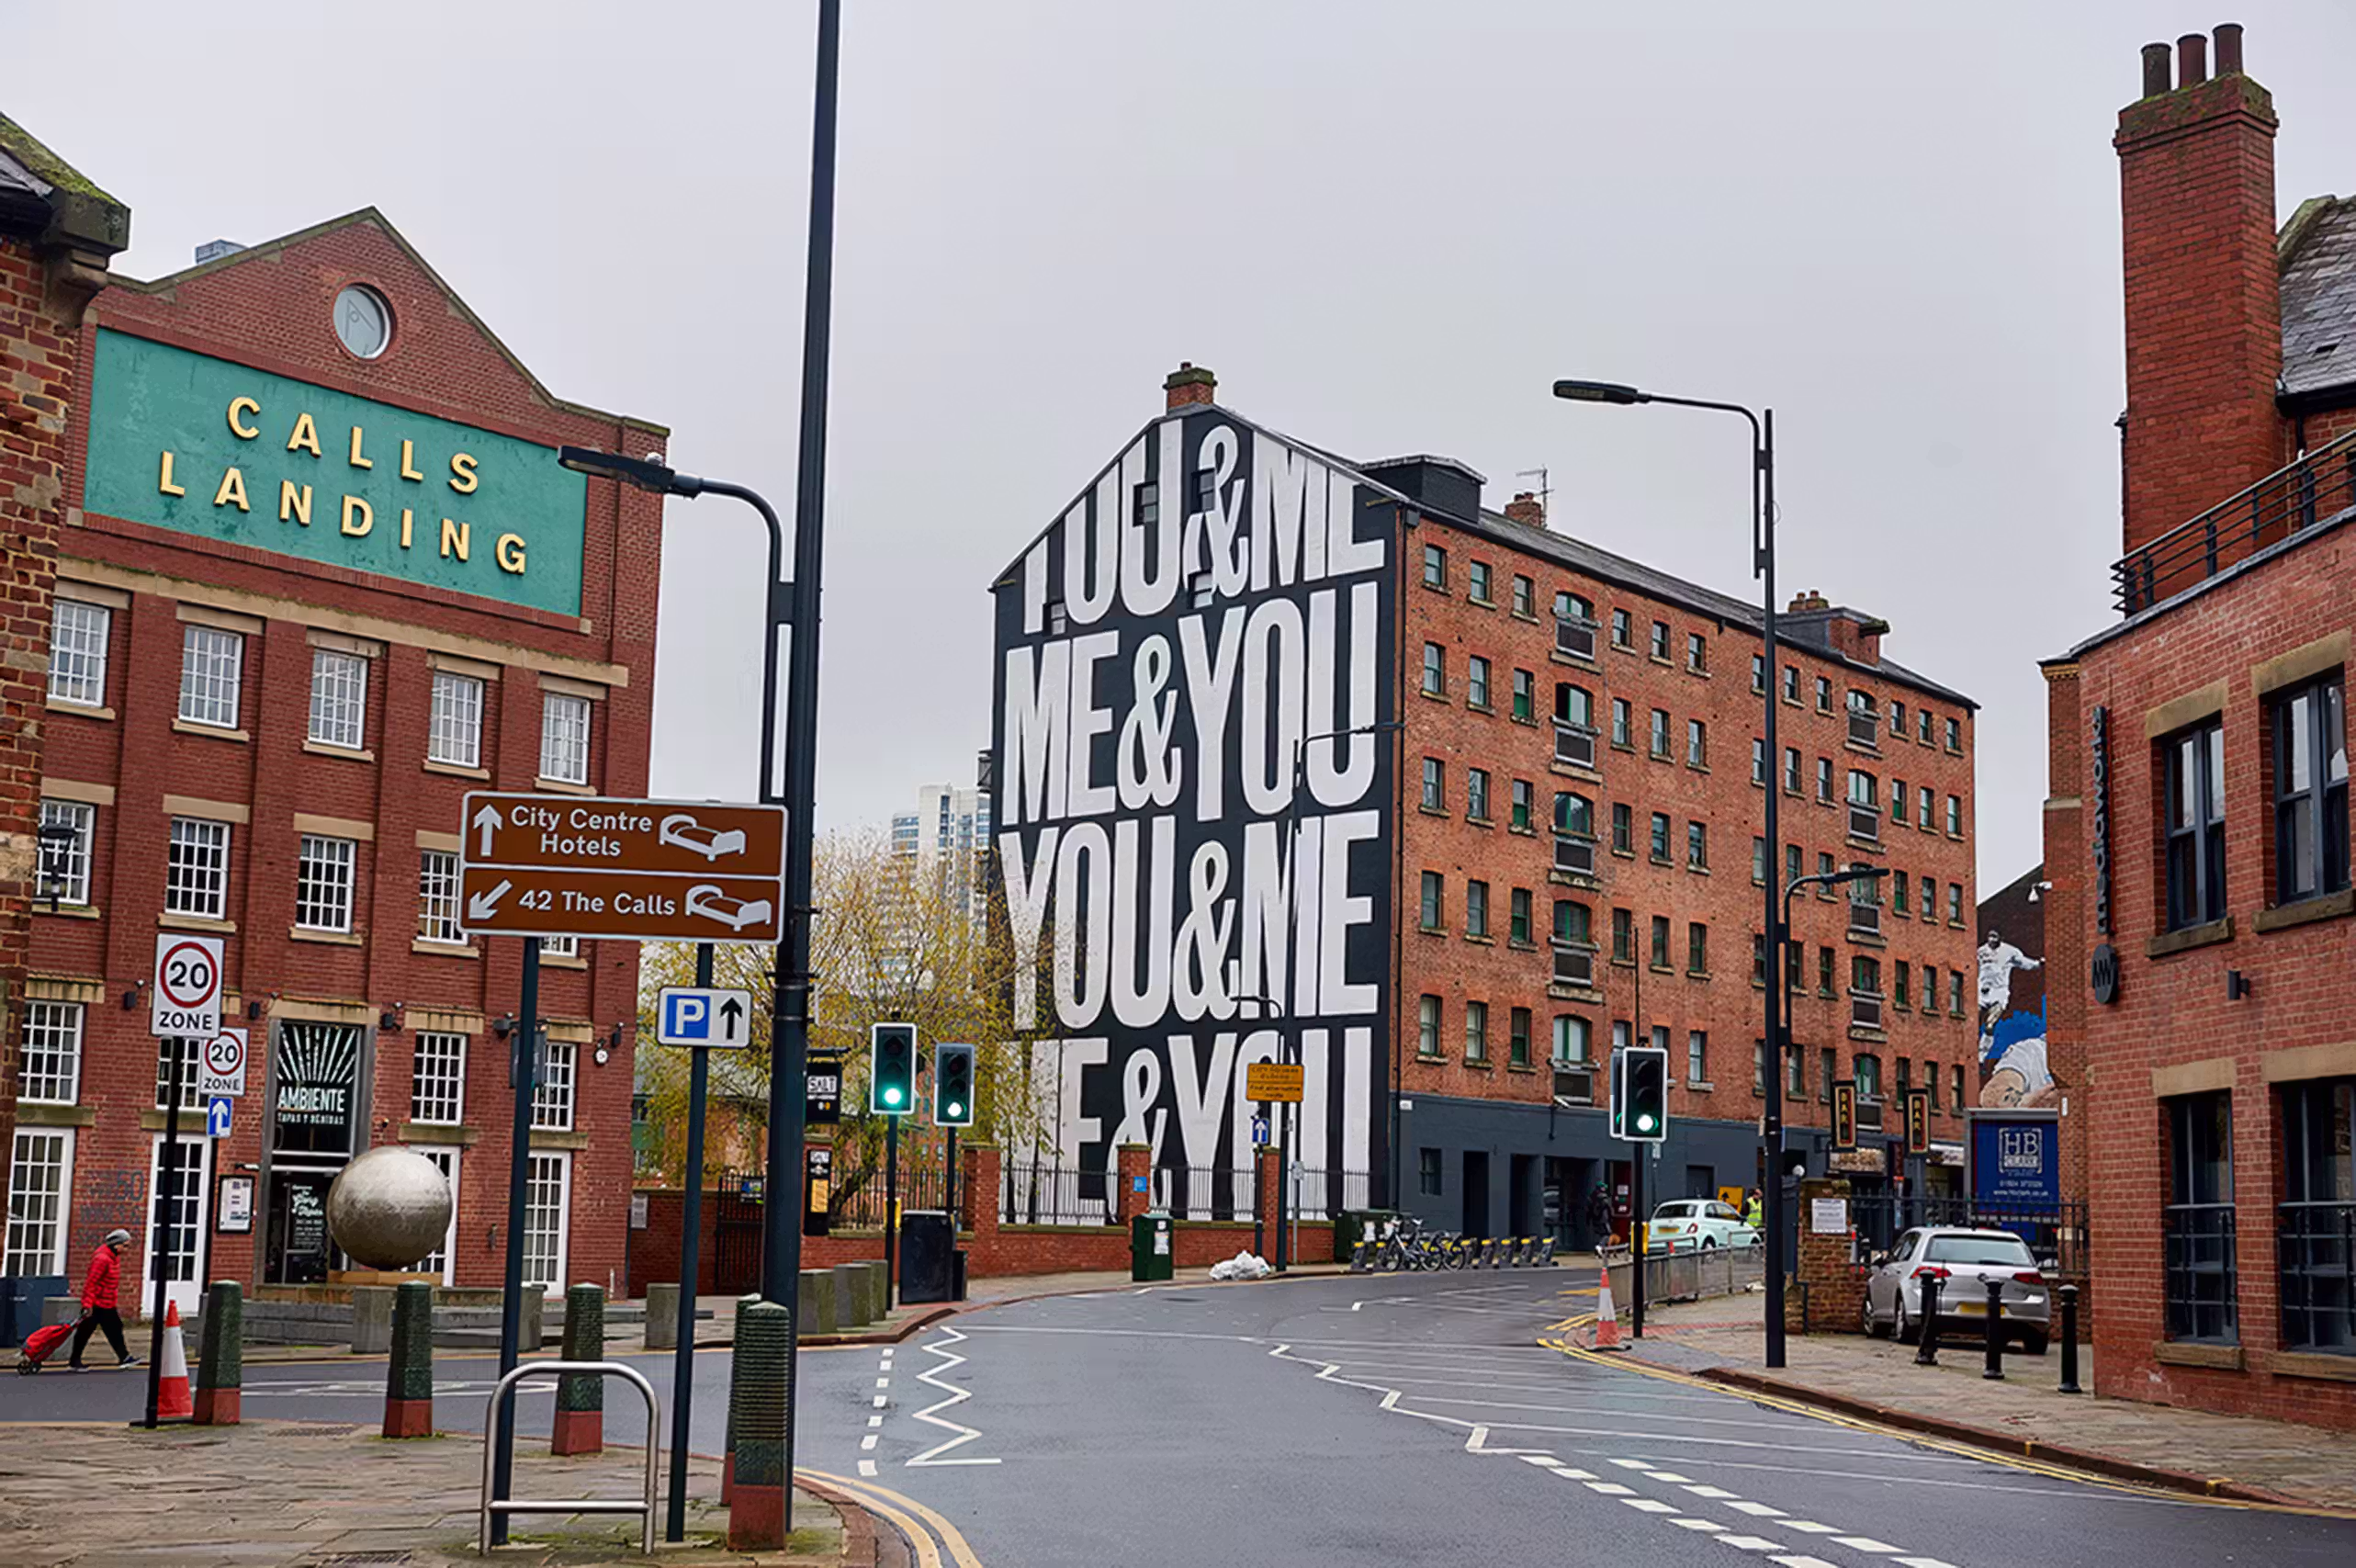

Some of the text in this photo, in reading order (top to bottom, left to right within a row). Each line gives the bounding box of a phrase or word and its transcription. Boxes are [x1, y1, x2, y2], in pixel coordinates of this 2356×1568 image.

[227, 397, 478, 494] CALLS
[160, 450, 526, 574] LANDING
[511, 806, 652, 832] City Centre
[541, 833, 621, 856] Hotels
[519, 890, 675, 916] 42 The Calls
[169, 961, 209, 989] 20
[159, 1011, 212, 1030] ZONE
[675, 998, 705, 1034] P
[210, 1044, 238, 1063] 20
[204, 1077, 240, 1090] ZONE
[807, 1076, 837, 1093] SALT
[276, 1086, 345, 1112] AMBIENTE
[2004, 1133, 2038, 1156] HB
